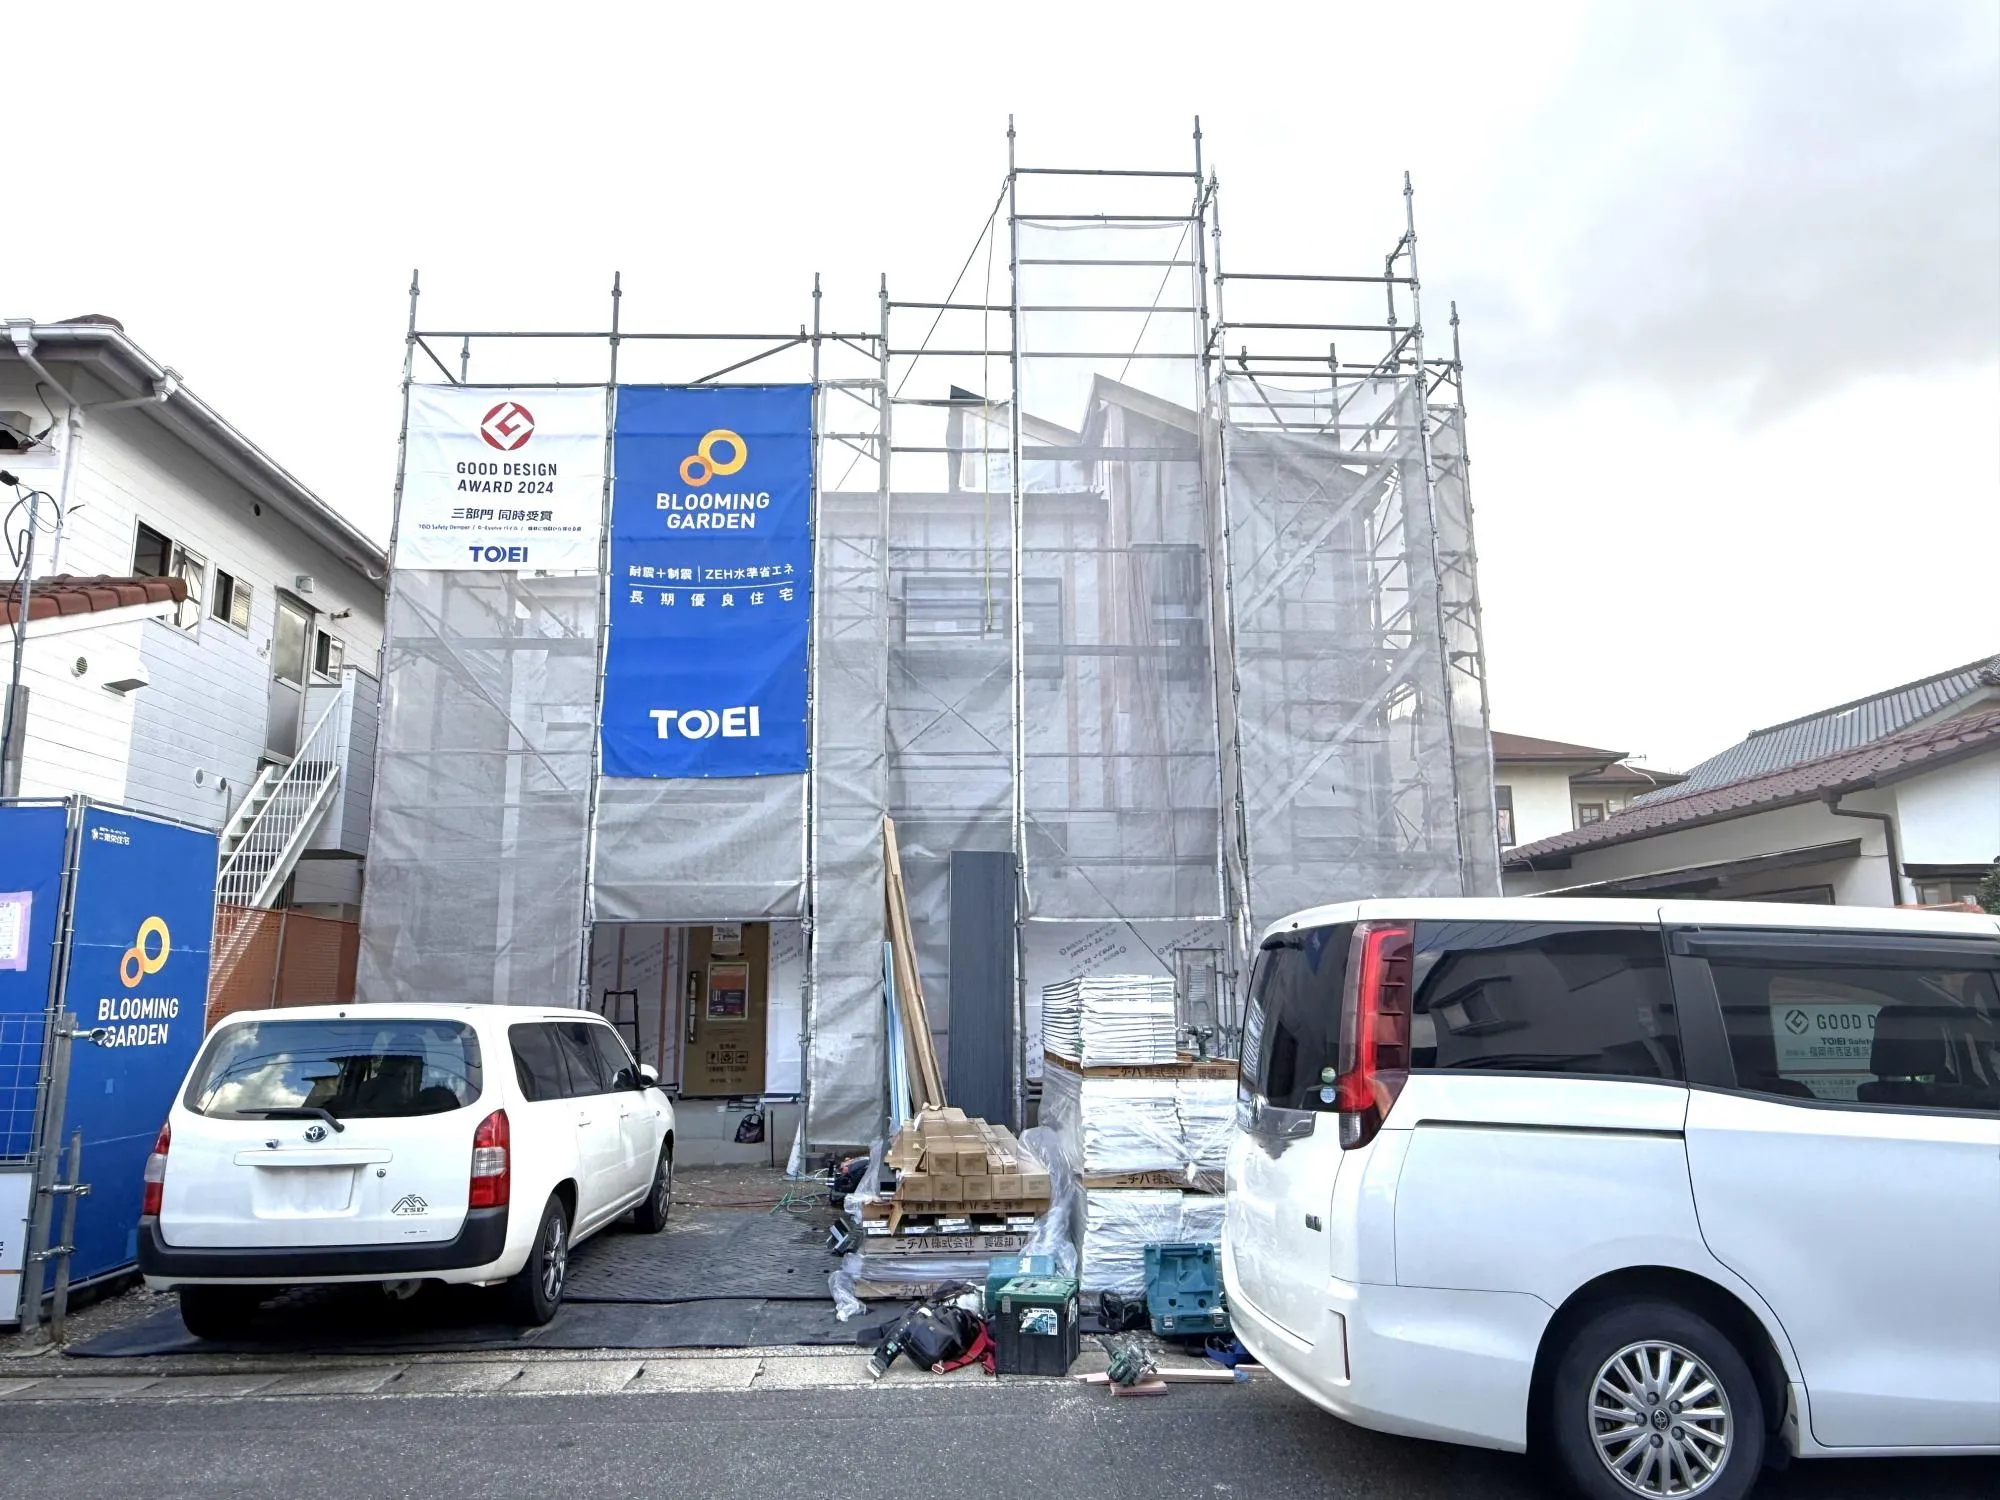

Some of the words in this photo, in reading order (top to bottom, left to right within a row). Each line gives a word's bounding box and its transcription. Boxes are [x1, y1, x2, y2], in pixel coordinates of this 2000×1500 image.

[456, 461, 498, 476] GOOD
[503, 462, 558, 477] DESIGN
[457, 479, 513, 493] AWARD
[517, 481, 554, 494] 2024
[656, 491, 770, 511] BLOOMING
[451, 507, 494, 521] 三部門
[498, 509, 554, 522] 同時受賞
[666, 511, 756, 530] GARDEN
[468, 545, 529, 563] TOEI
[629, 587, 794, 608] 長期優良住宅
[649, 705, 761, 740] TOEI
[98, 998, 179, 1021] BLOOMING
[1816, 1014, 1862, 1030] GOOD
[104, 1023, 169, 1048] GARDEN
